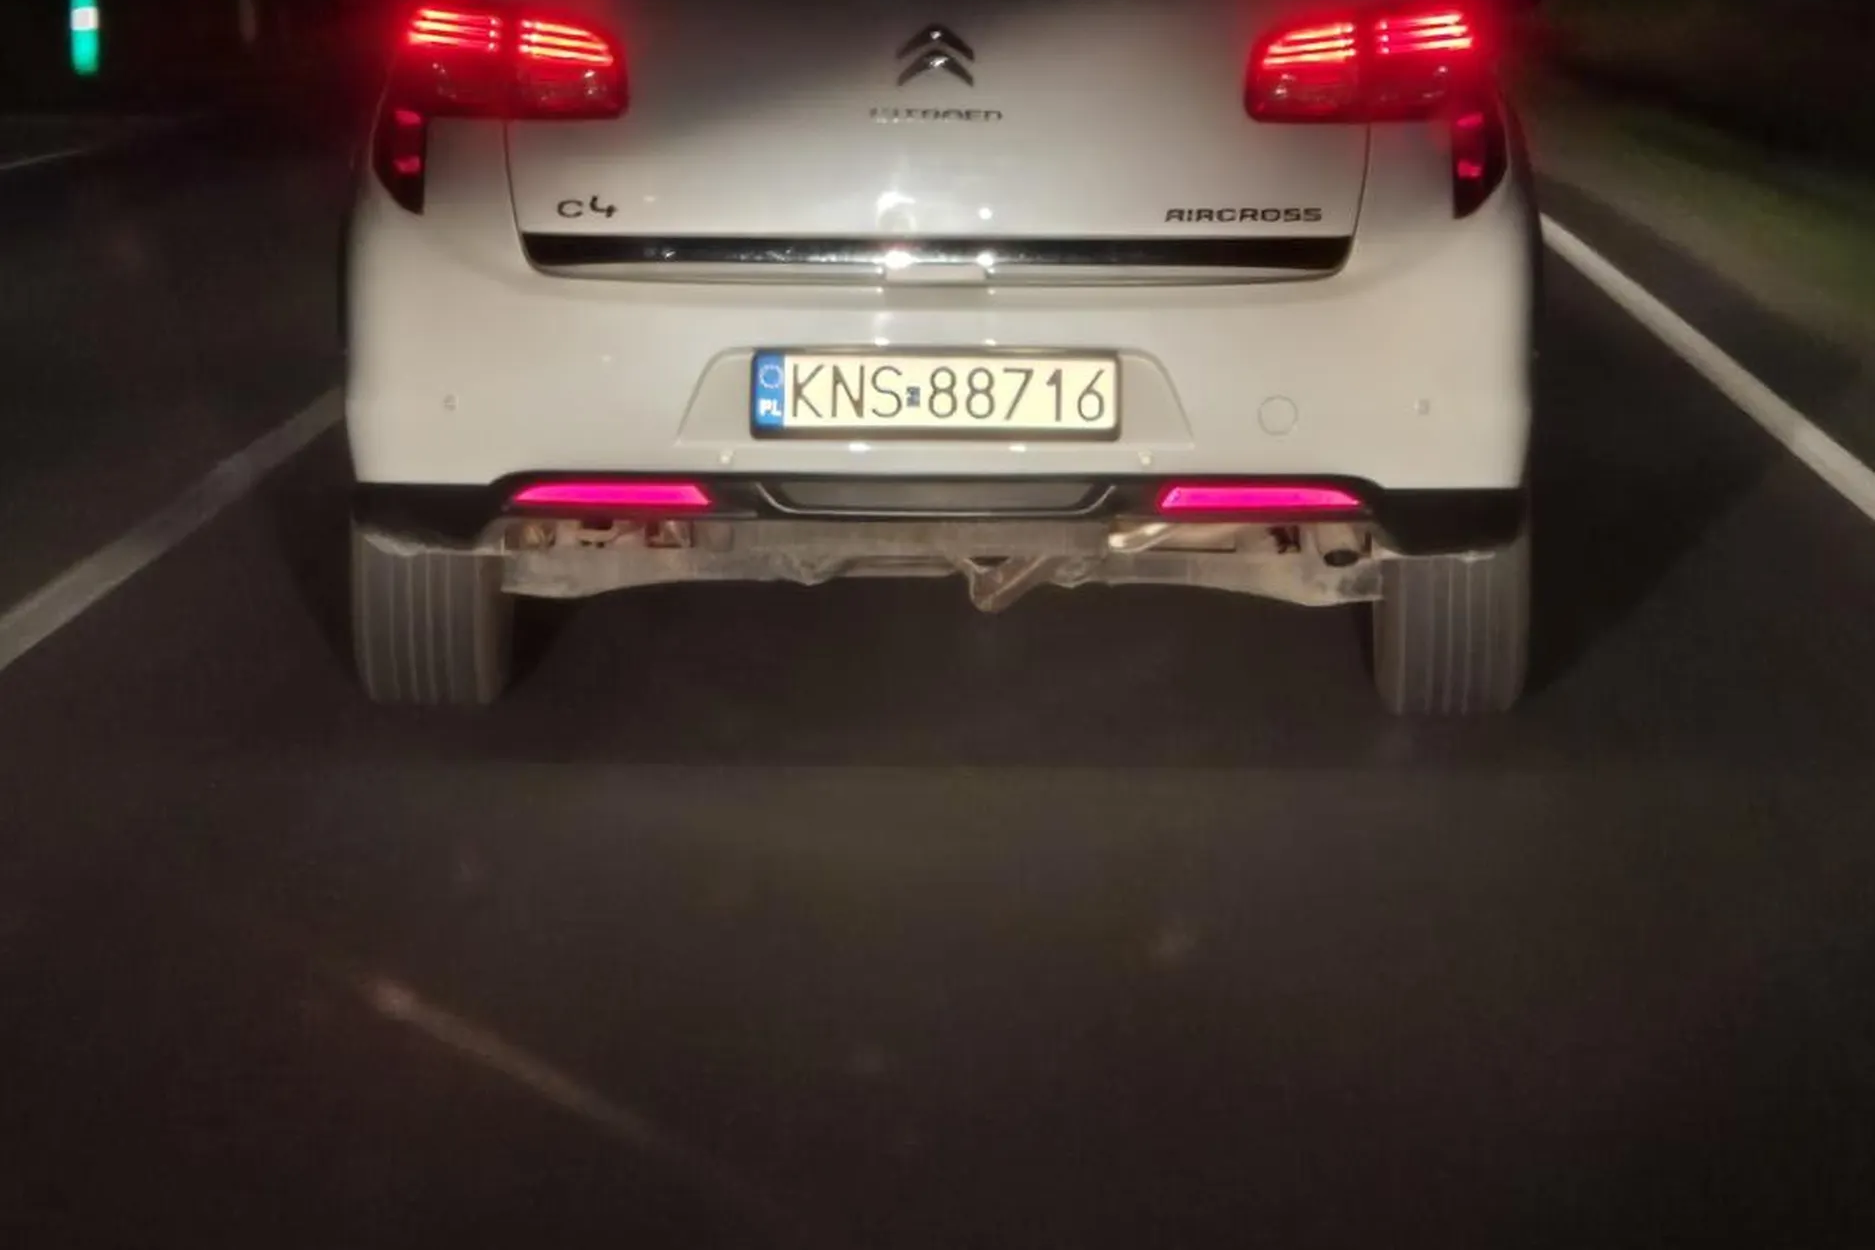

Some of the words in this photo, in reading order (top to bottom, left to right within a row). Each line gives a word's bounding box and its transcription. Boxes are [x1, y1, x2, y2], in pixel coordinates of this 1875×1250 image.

[557, 195, 618, 218] C4
[1164, 207, 1323, 222] AIRCROSS
[792, 363, 903, 419] KNS
[927, 365, 1106, 423] 88716
[759, 398, 783, 417] PL
